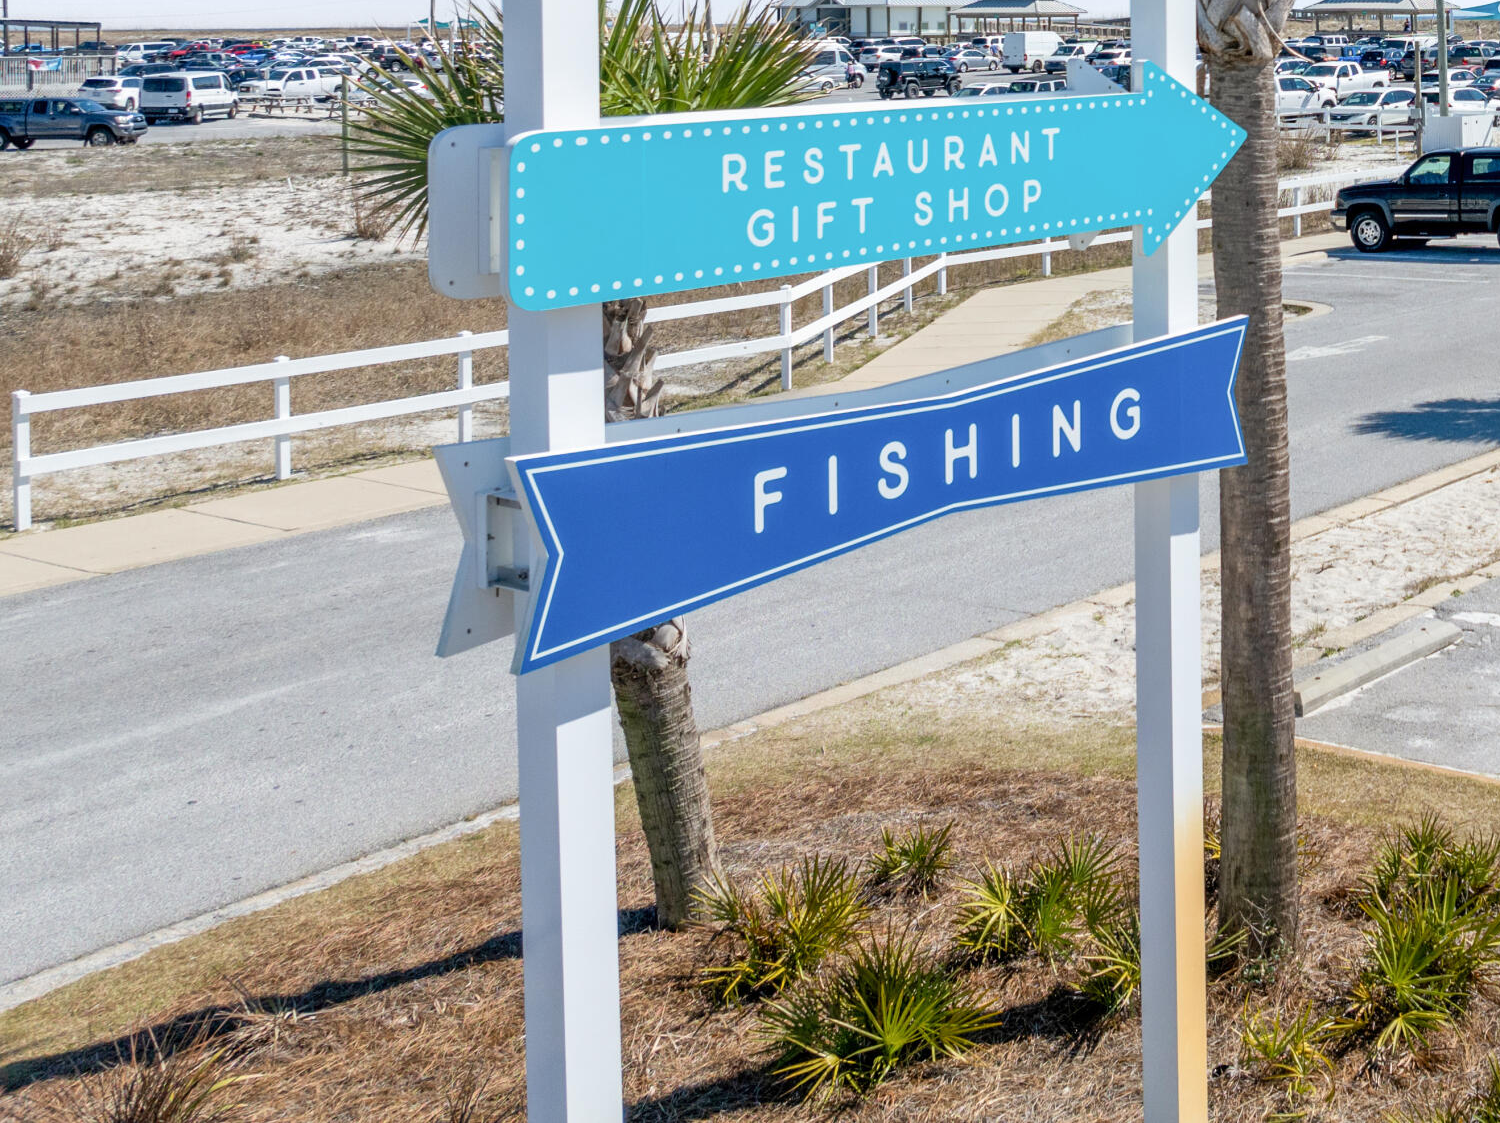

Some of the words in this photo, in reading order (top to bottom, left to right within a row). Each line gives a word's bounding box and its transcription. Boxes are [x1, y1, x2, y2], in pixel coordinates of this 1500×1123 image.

[722, 128, 1061, 193] RESTAURANT
[746, 197, 874, 247] GIFT
[914, 180, 1043, 227] SHOP
[754, 388, 1142, 534] FISHING
